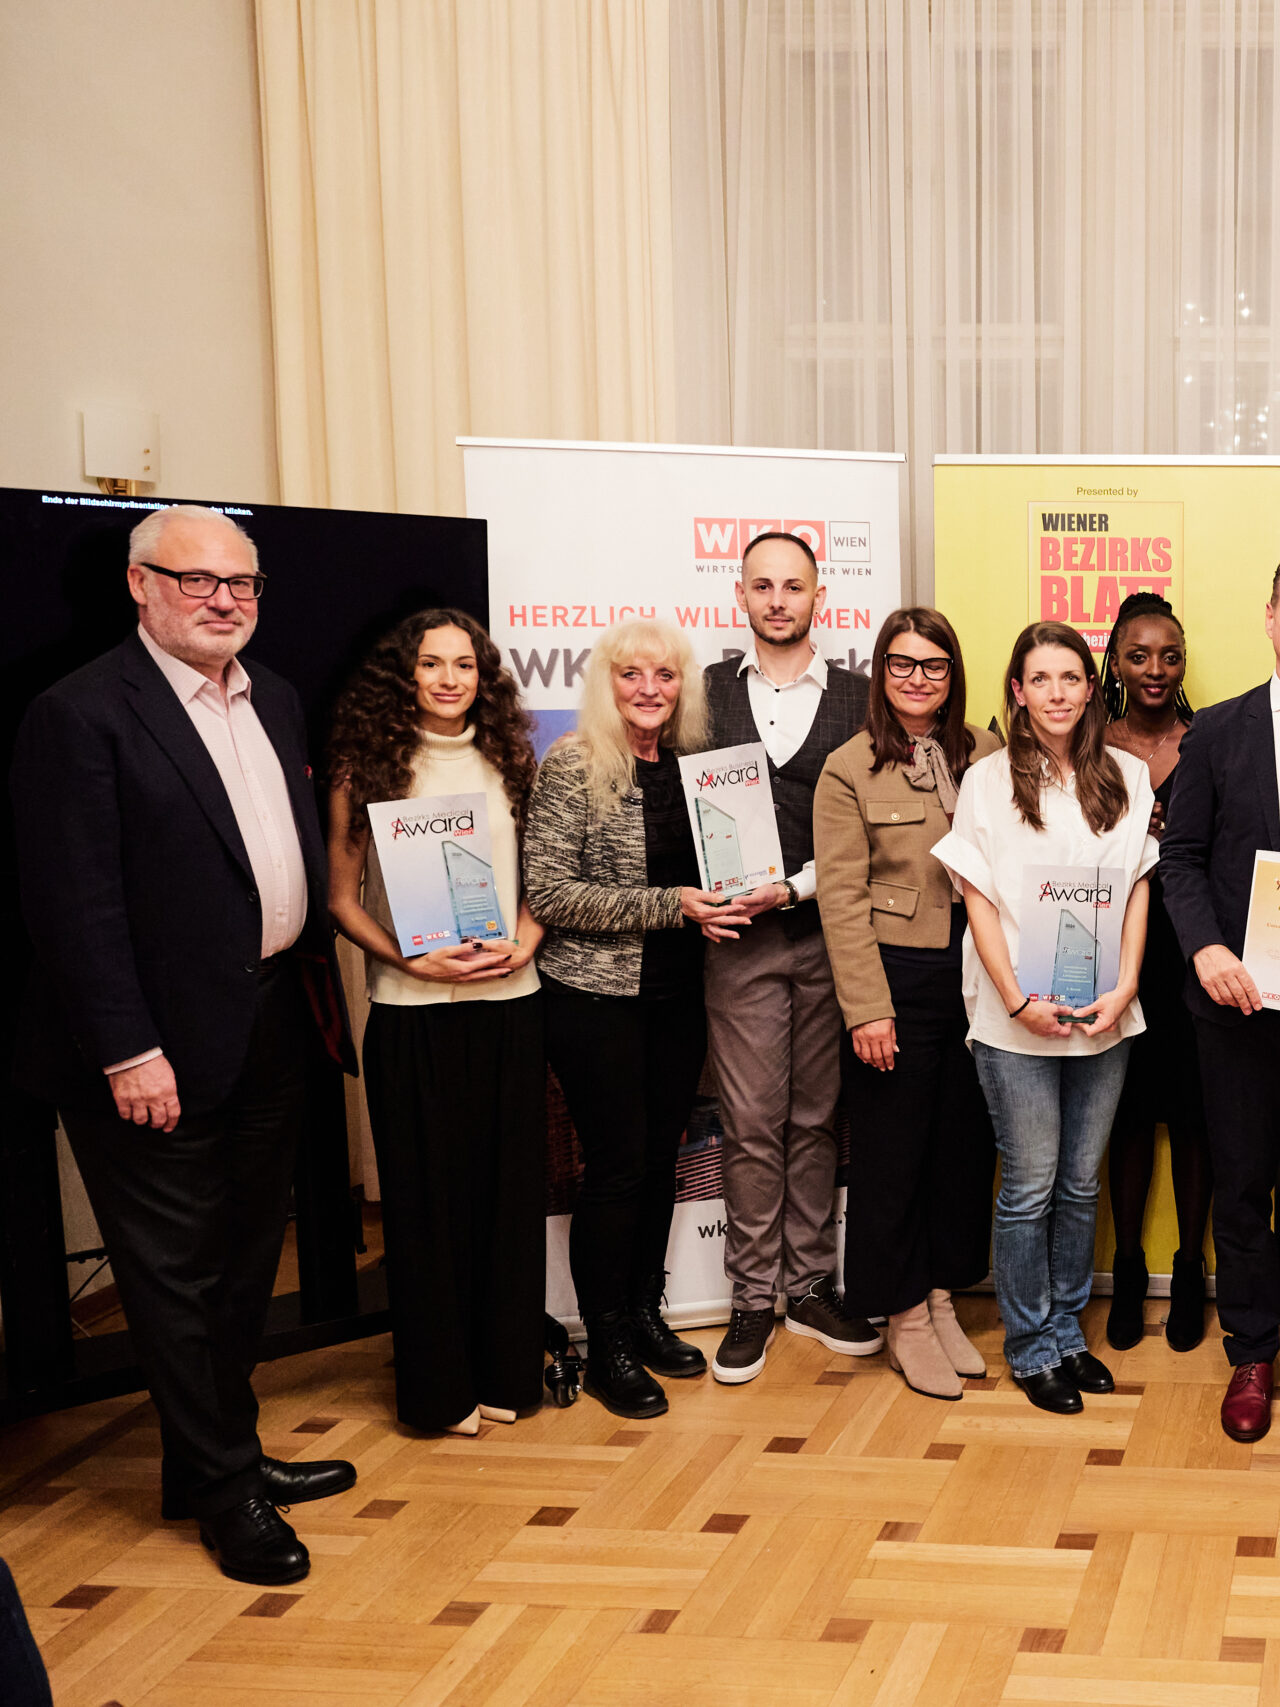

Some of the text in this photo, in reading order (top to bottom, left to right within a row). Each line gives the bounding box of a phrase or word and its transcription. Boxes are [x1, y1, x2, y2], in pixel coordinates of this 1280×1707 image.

[42, 495, 63, 504] Ende
[65, 497, 79, 505] der
[1076, 487, 1139, 498] Presented by
[1041, 513, 1109, 532] WIENER
[833, 537, 867, 547] WIEN
[1040, 536, 1172, 572] BEZIRKS
[842, 568, 872, 576] WIEN
[675, 606, 870, 629] WILLMEN
[696, 761, 759, 791] Award
[432, 809, 470, 818] Medical
[392, 810, 474, 840] Award
[1039, 881, 1112, 902] Award
